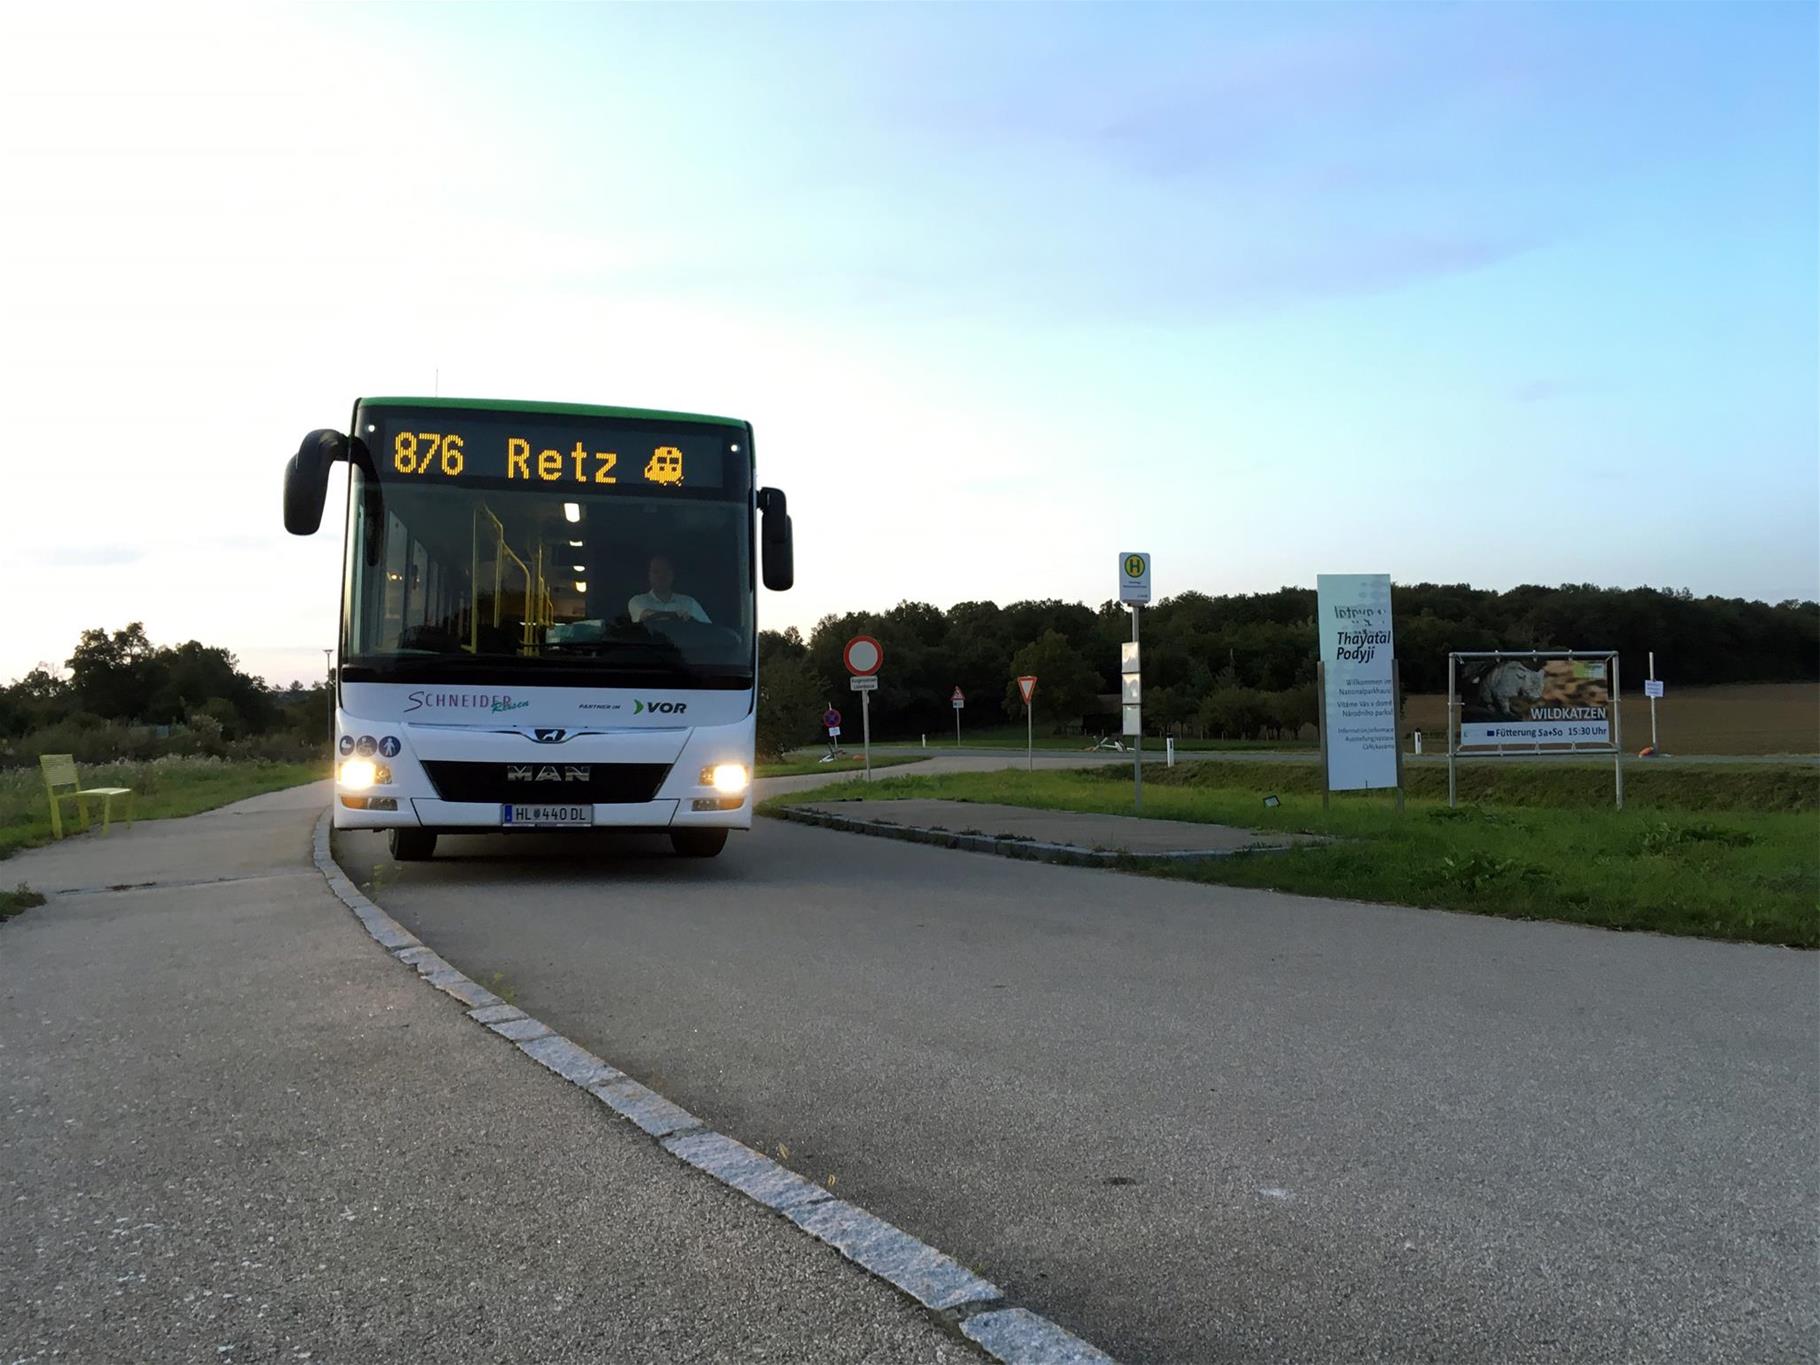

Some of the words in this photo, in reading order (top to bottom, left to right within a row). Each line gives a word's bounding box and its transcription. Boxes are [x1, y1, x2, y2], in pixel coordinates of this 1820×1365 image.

[394, 431, 464, 476] 876
[507, 437, 617, 483] Retz
[1337, 630, 1391, 649] Thayatal
[403, 691, 513, 713] SCHNEIDER
[647, 702, 687, 714] VOR
[1530, 706, 1606, 720] WILDKATZEN
[1495, 727, 1537, 739] Fütterung
[1538, 729, 1563, 737] Sa+So
[1568, 727, 1591, 736] 15:30
[1592, 726, 1607, 736] Uhr
[507, 765, 591, 782] MAN
[516, 807, 531, 821] HL
